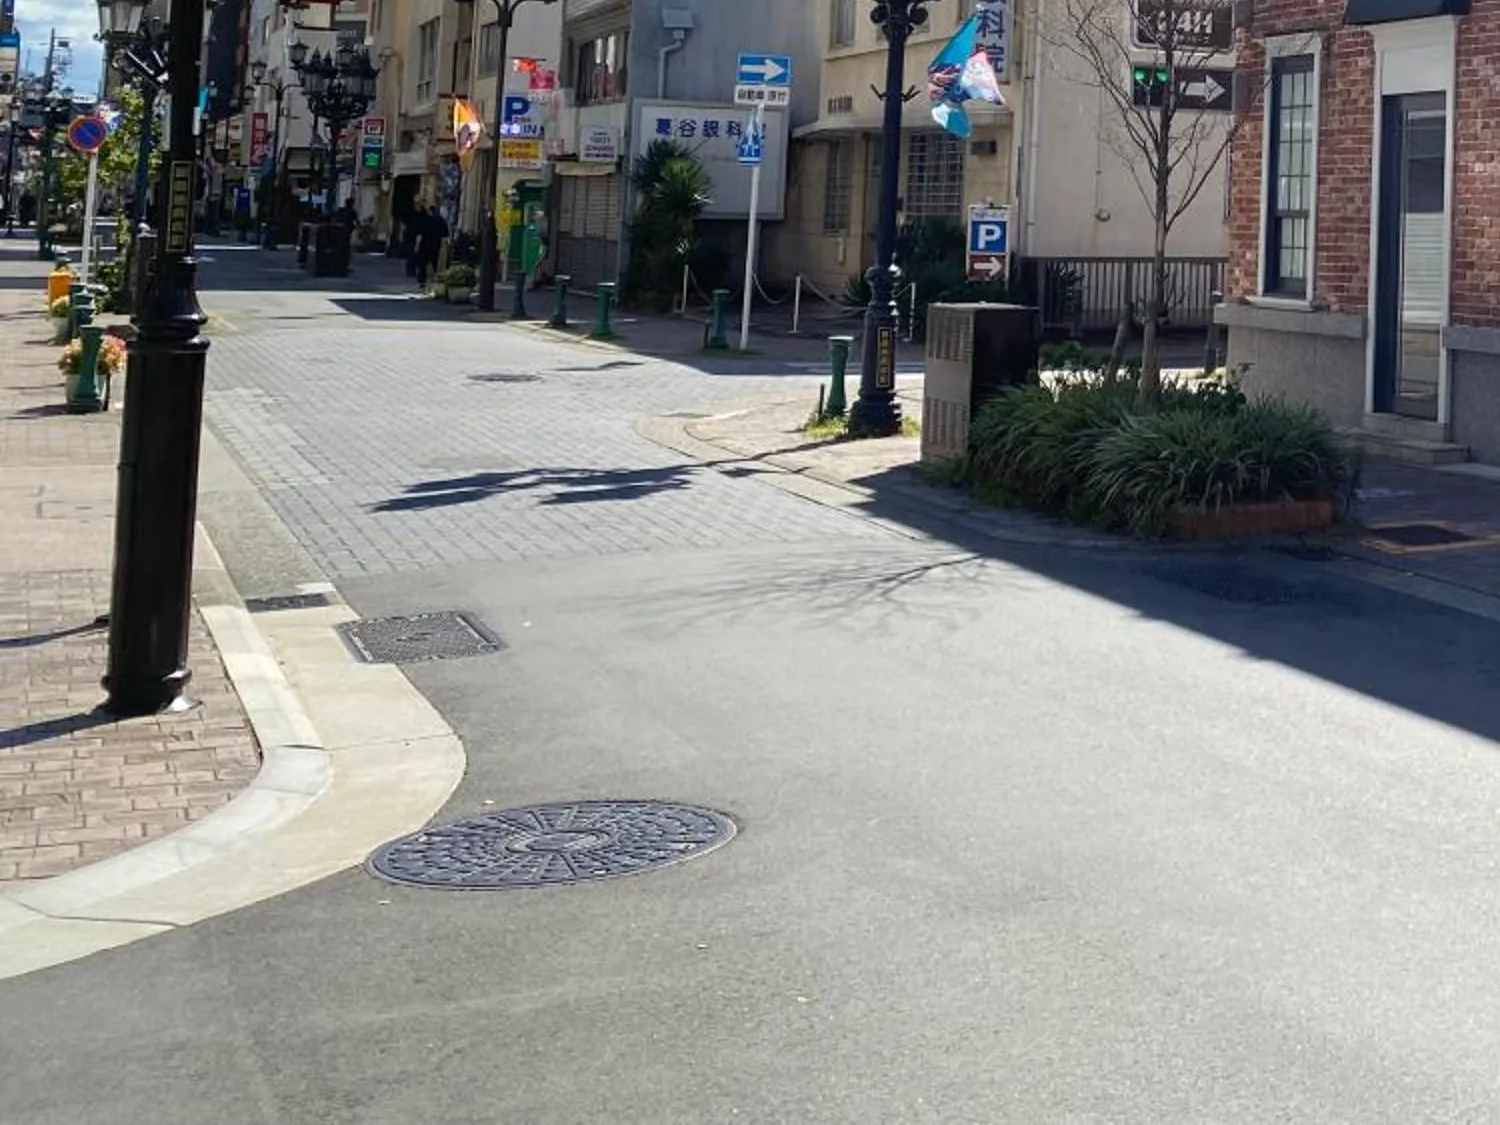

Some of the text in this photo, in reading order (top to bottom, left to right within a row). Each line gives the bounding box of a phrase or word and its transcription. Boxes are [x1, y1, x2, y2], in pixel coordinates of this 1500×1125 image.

[505, 96, 531, 125] P
[656, 118, 767, 139] 葛谷眼科
[978, 223, 1002, 250] P
